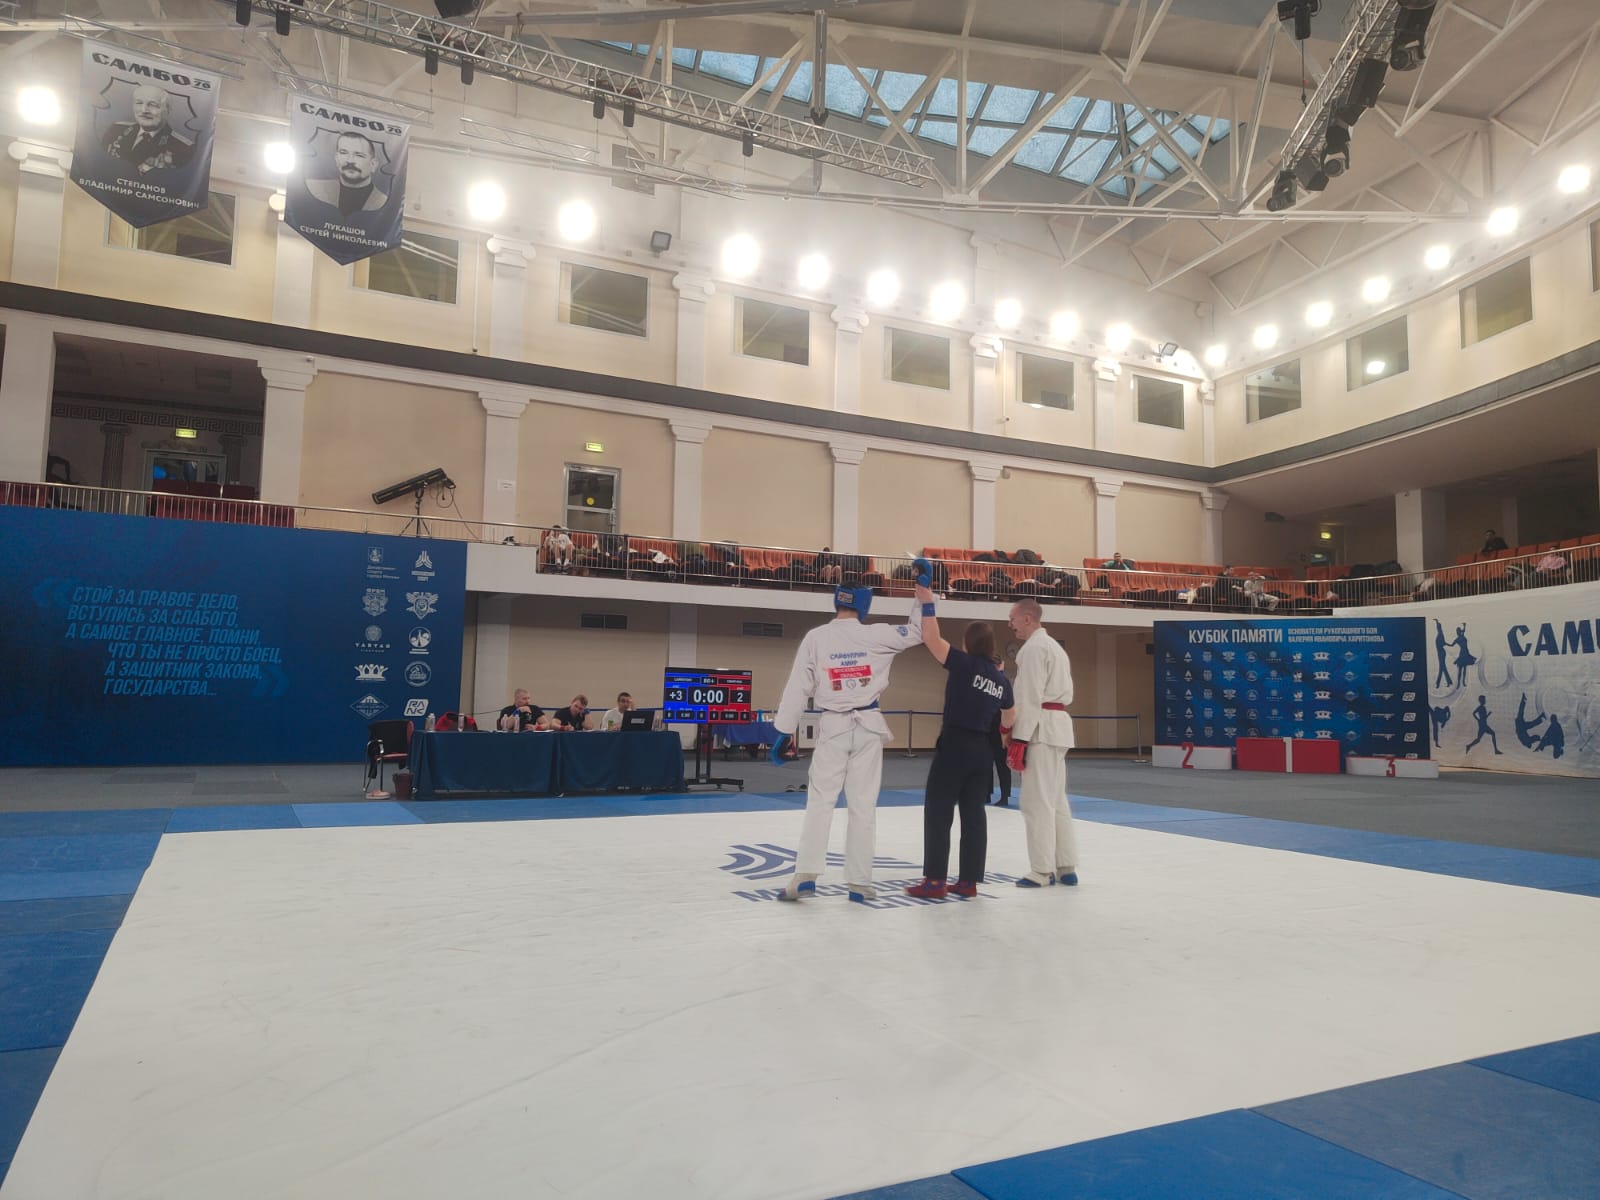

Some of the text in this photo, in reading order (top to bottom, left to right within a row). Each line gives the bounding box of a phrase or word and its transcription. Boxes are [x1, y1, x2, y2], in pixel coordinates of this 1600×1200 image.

[92, 52, 211, 89] САМБО 70
[300, 102, 385, 131] САМБО
[79, 178, 200, 209] ВЛАДИМИР САМСОНОВИЧ
[116, 177, 166, 194] СТЕПАНОВ
[300, 225, 388, 249] СЕРГЕЙ НИКОЛАЕВИЧ
[324, 222, 365, 236] ЛУКАШОВ
[72, 585, 239, 611] СТОЙ ЗА ПРАВОЕ ДЕЛО,
[67, 604, 145, 623] ВСТУПИСЬ
[149, 608, 169, 624] ЗА
[65, 623, 77, 639] А
[79, 624, 134, 641] САМОЕ
[1188, 628, 1283, 644] КУБОК ПАМЯТИ
[108, 642, 283, 664] ЧТО ТЫ НЕ ПРОСТО БОЕЦ,
[104, 661, 116, 676] А
[119, 661, 204, 679] ЗАЩИТНИК
[669, 690, 683, 701] +3
[693, 689, 724, 704] 0:00
[972, 674, 1004, 700] СУДЬЯ
[736, 692, 744, 703] 2
[1181, 742, 1194, 769] 2
[1282, 737, 1293, 773] 1
[1385, 757, 1396, 777] 3
